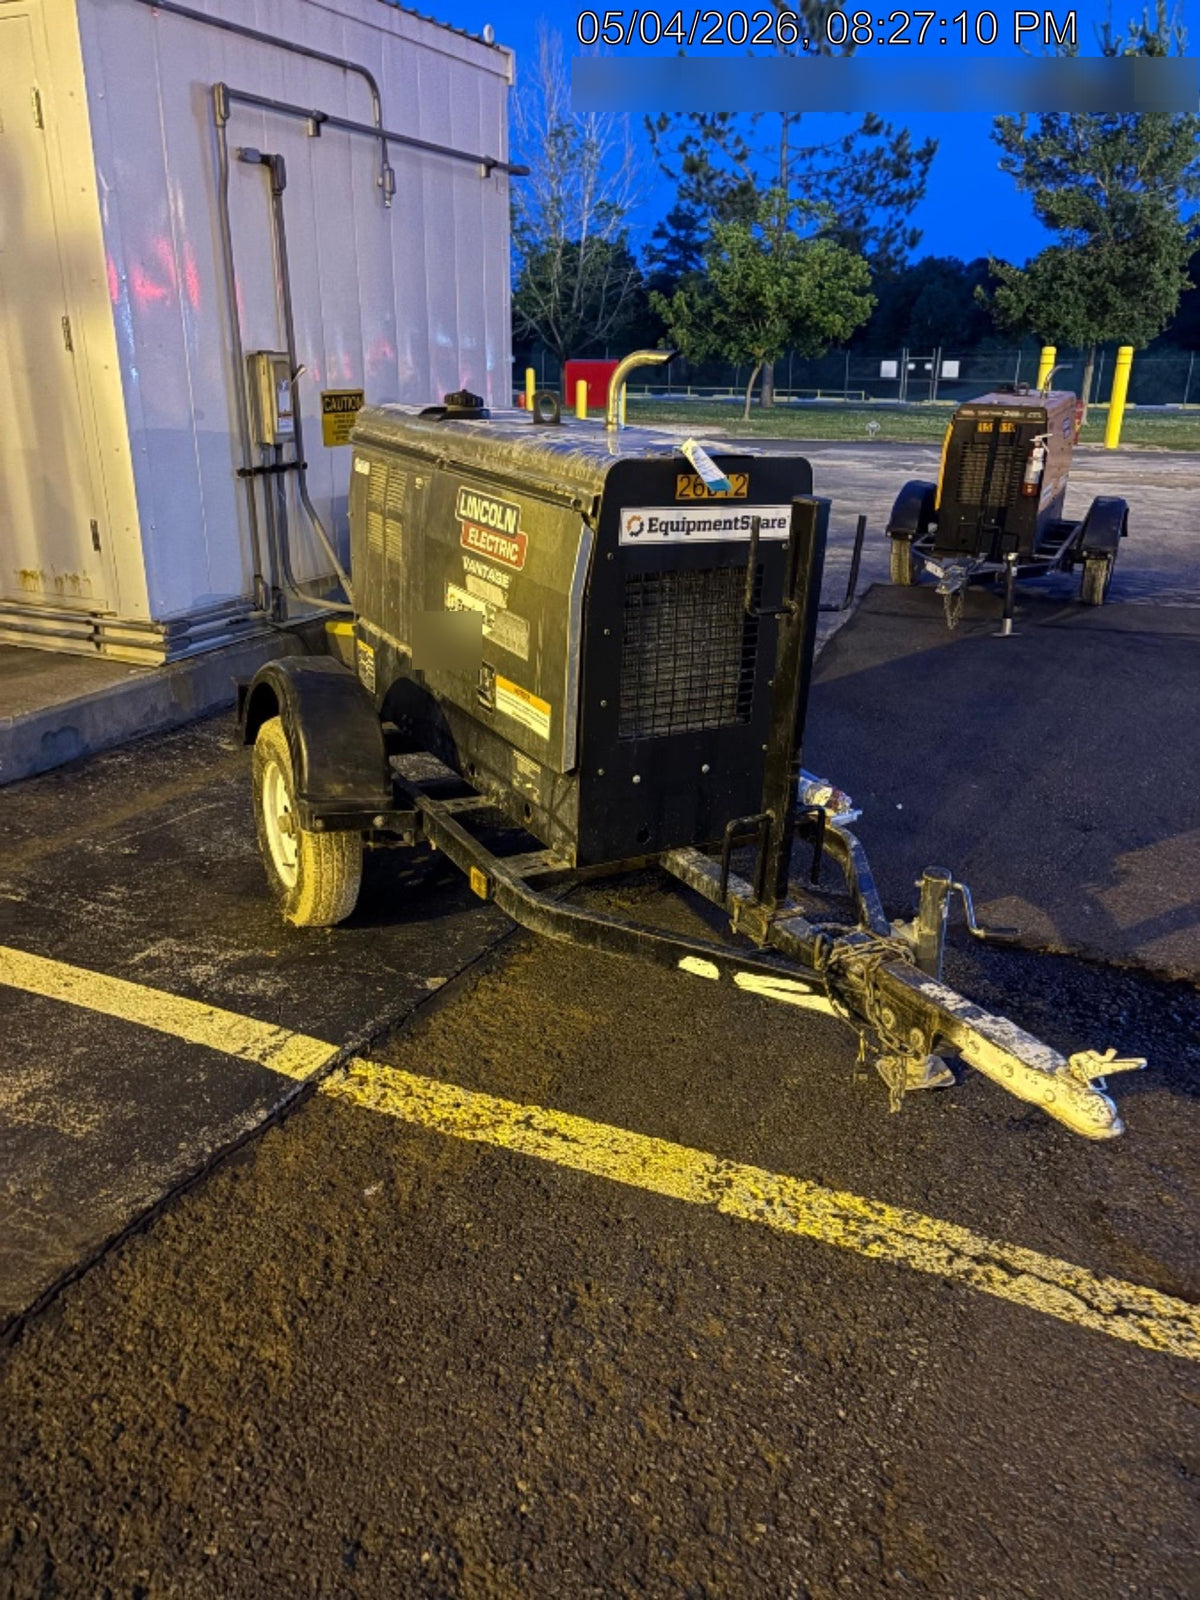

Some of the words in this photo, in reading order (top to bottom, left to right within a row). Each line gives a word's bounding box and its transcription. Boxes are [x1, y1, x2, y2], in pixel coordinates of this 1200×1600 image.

[679, 474, 747, 497] 262
[459, 492, 517, 534] LINCOLN
[647, 515, 787, 535] EquipmentSare
[468, 527, 519, 562] ELECTRIC
